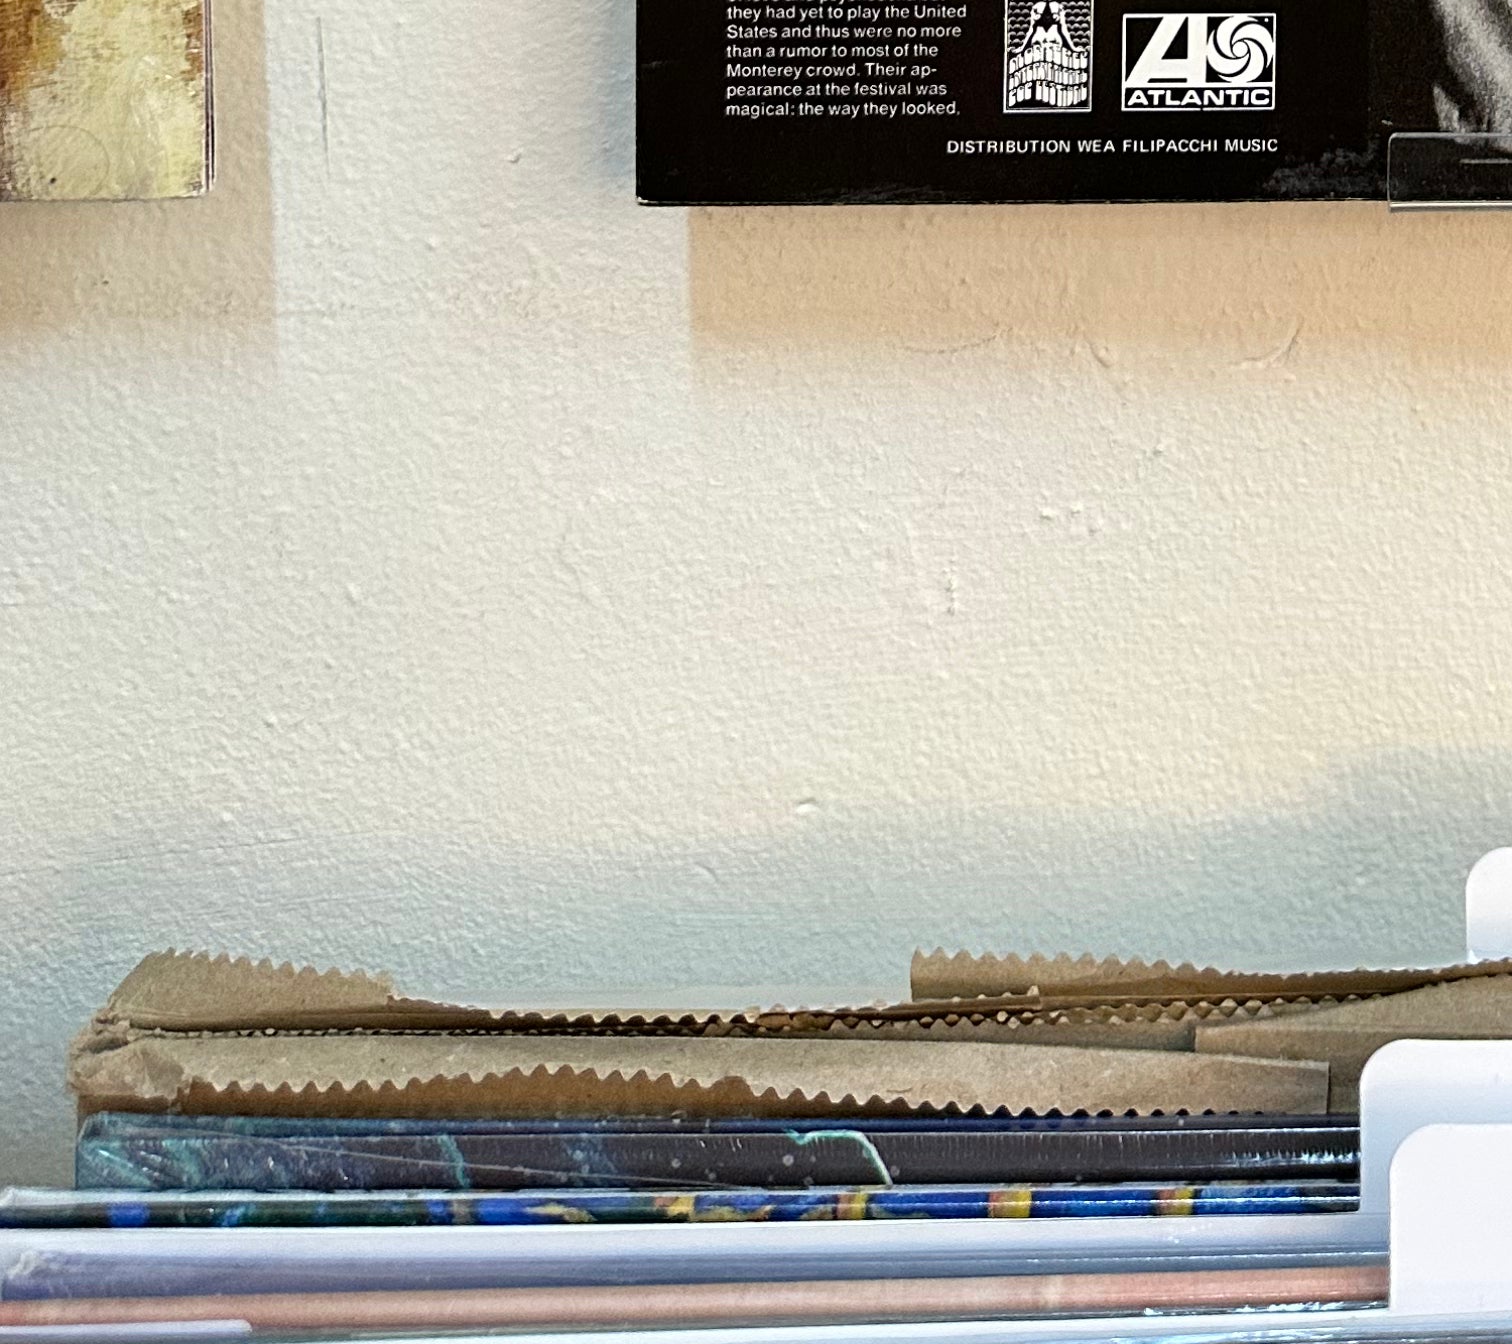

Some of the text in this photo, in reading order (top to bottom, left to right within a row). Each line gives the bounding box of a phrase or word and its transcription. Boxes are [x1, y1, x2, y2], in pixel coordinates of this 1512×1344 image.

[1127, 89, 1271, 106] ATLANTIC
[798, 102, 824, 116] the
[828, 104, 860, 118] way
[863, 102, 898, 118] they
[946, 138, 1278, 154] DISTRIBUTION WEA FILIPACCHI MUSIC
